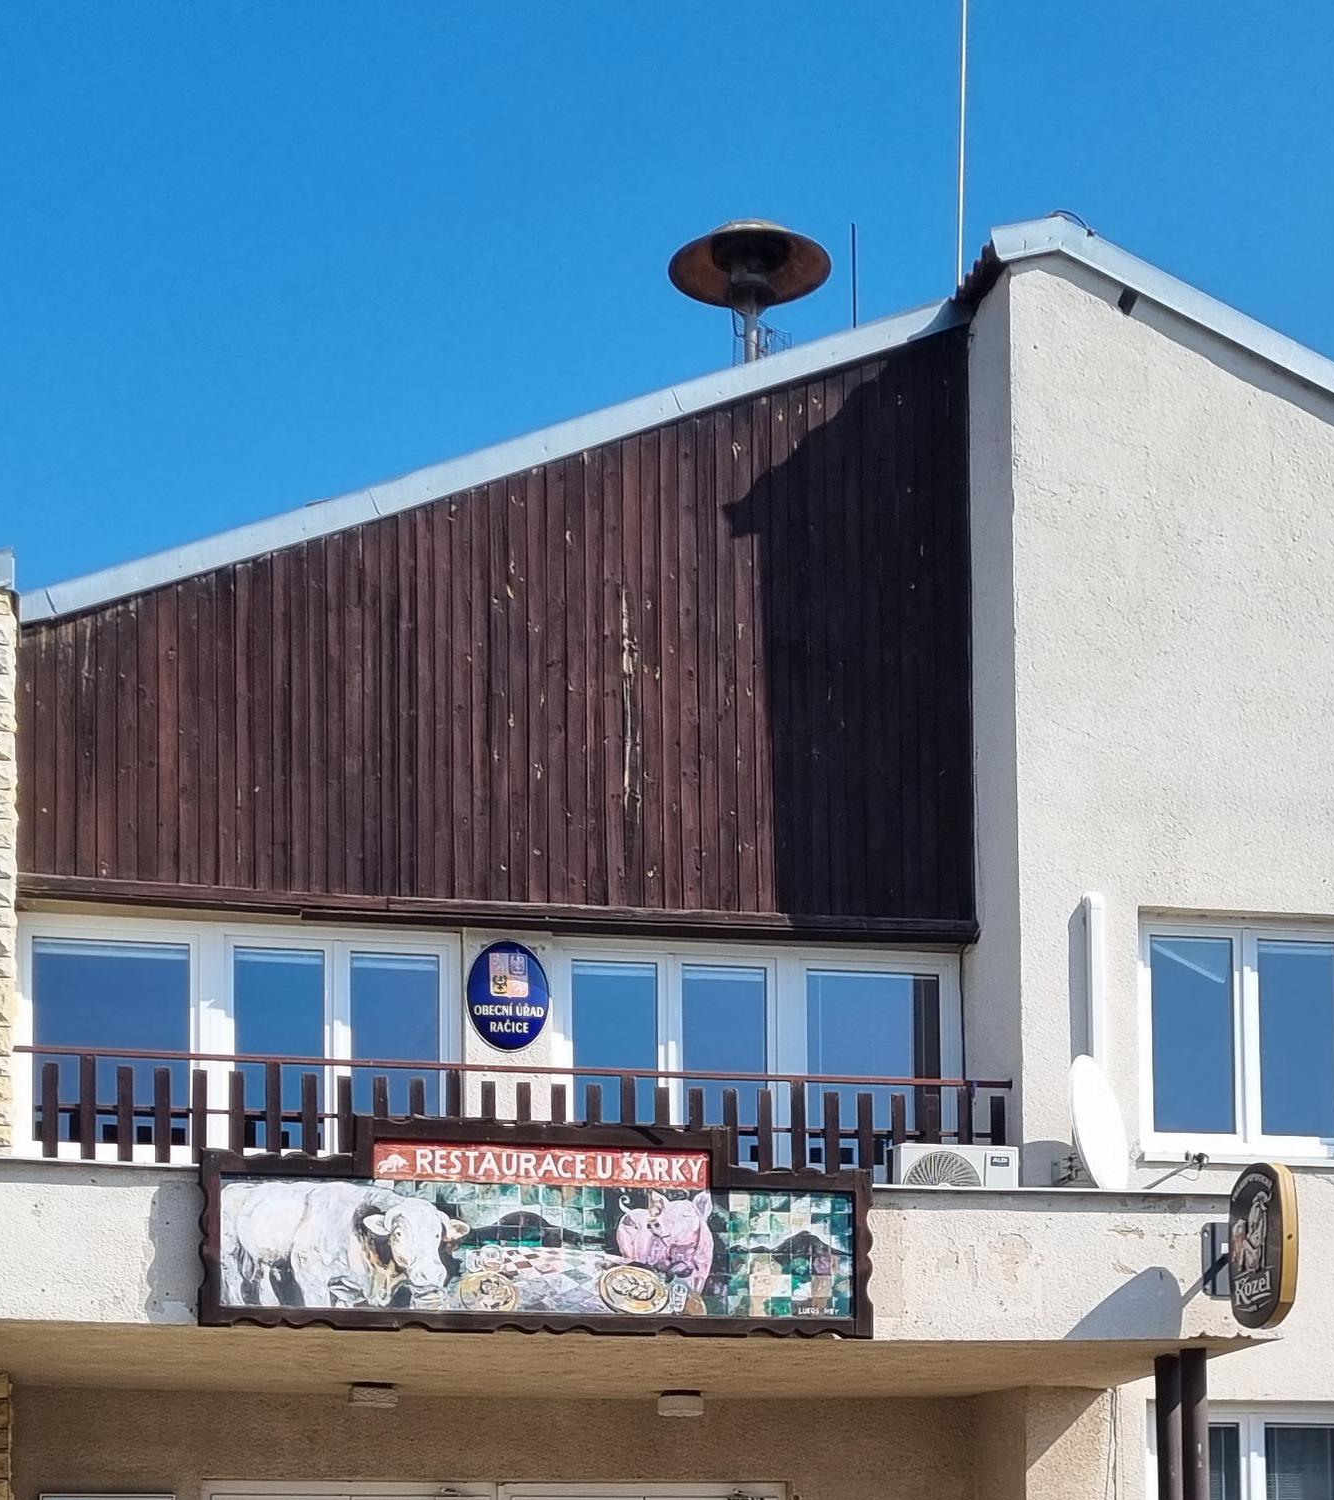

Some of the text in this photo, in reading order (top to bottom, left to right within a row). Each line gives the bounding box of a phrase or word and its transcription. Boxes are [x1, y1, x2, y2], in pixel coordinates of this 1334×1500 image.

[474, 1002, 544, 1018] OBECNÍ ÚŘAD
[490, 1019, 529, 1033] RAČICE
[416, 1148, 704, 1182] RESTAURACE U ŠÁRKY
[1235, 1271, 1271, 1305] Kozel
